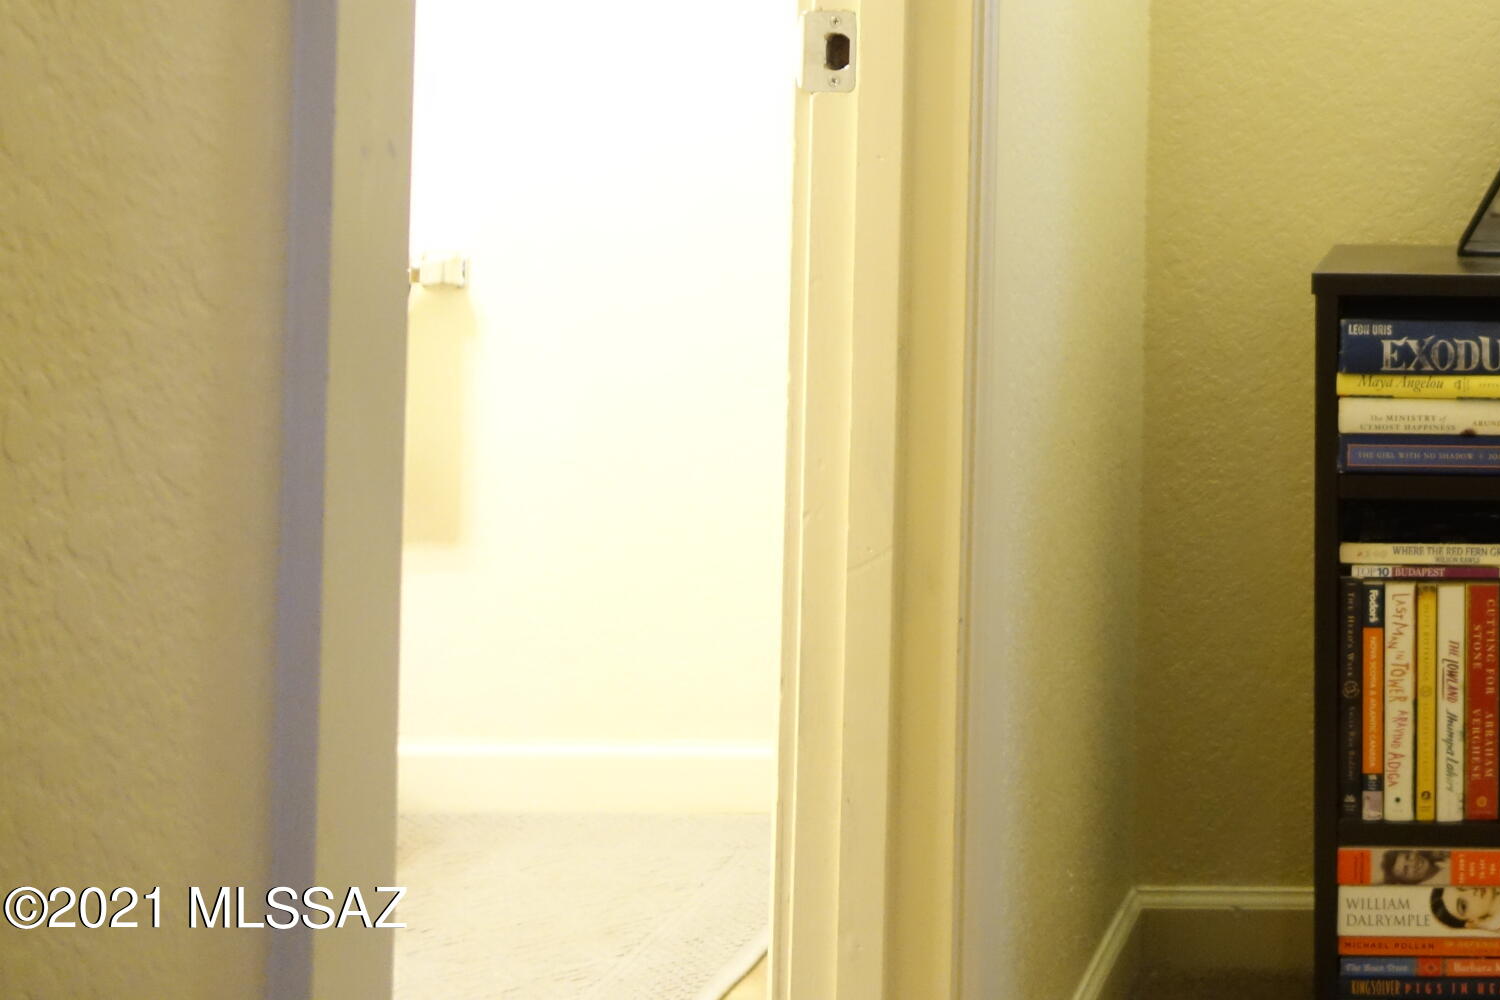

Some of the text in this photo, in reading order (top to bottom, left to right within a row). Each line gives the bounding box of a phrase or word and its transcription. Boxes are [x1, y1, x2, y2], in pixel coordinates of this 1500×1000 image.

[1357, 374, 1444, 392] Maya Angelou
[1393, 546, 1424, 556] WHERE
[1427, 547, 1444, 556] THE
[1446, 547, 1463, 556] RED
[1466, 547, 1487, 557] FERN
[1394, 567, 1447, 578] BUDAPEST
[1391, 593, 1411, 620] LAST
[1388, 622, 1409, 649] MAN
[1472, 624, 1482, 670] STONE
[1485, 599, 1496, 696] CUTTING FOR
[1387, 662, 1410, 703] TOWER
[1442, 640, 1461, 704] THE LOWLAND
[1386, 710, 1409, 788] ARAVIND ADIGA
[1471, 708, 1482, 782] VERGHESE
[1484, 712, 1495, 778] ABRAHAM
[1346, 897, 1410, 910] WILLIAM
[1346, 913, 1431, 927] DALRYMPLE
[1344, 942, 1389, 950] MICHAEL
[1394, 942, 1435, 950] POLLAN
[1403, 982, 1443, 995] PIGS
